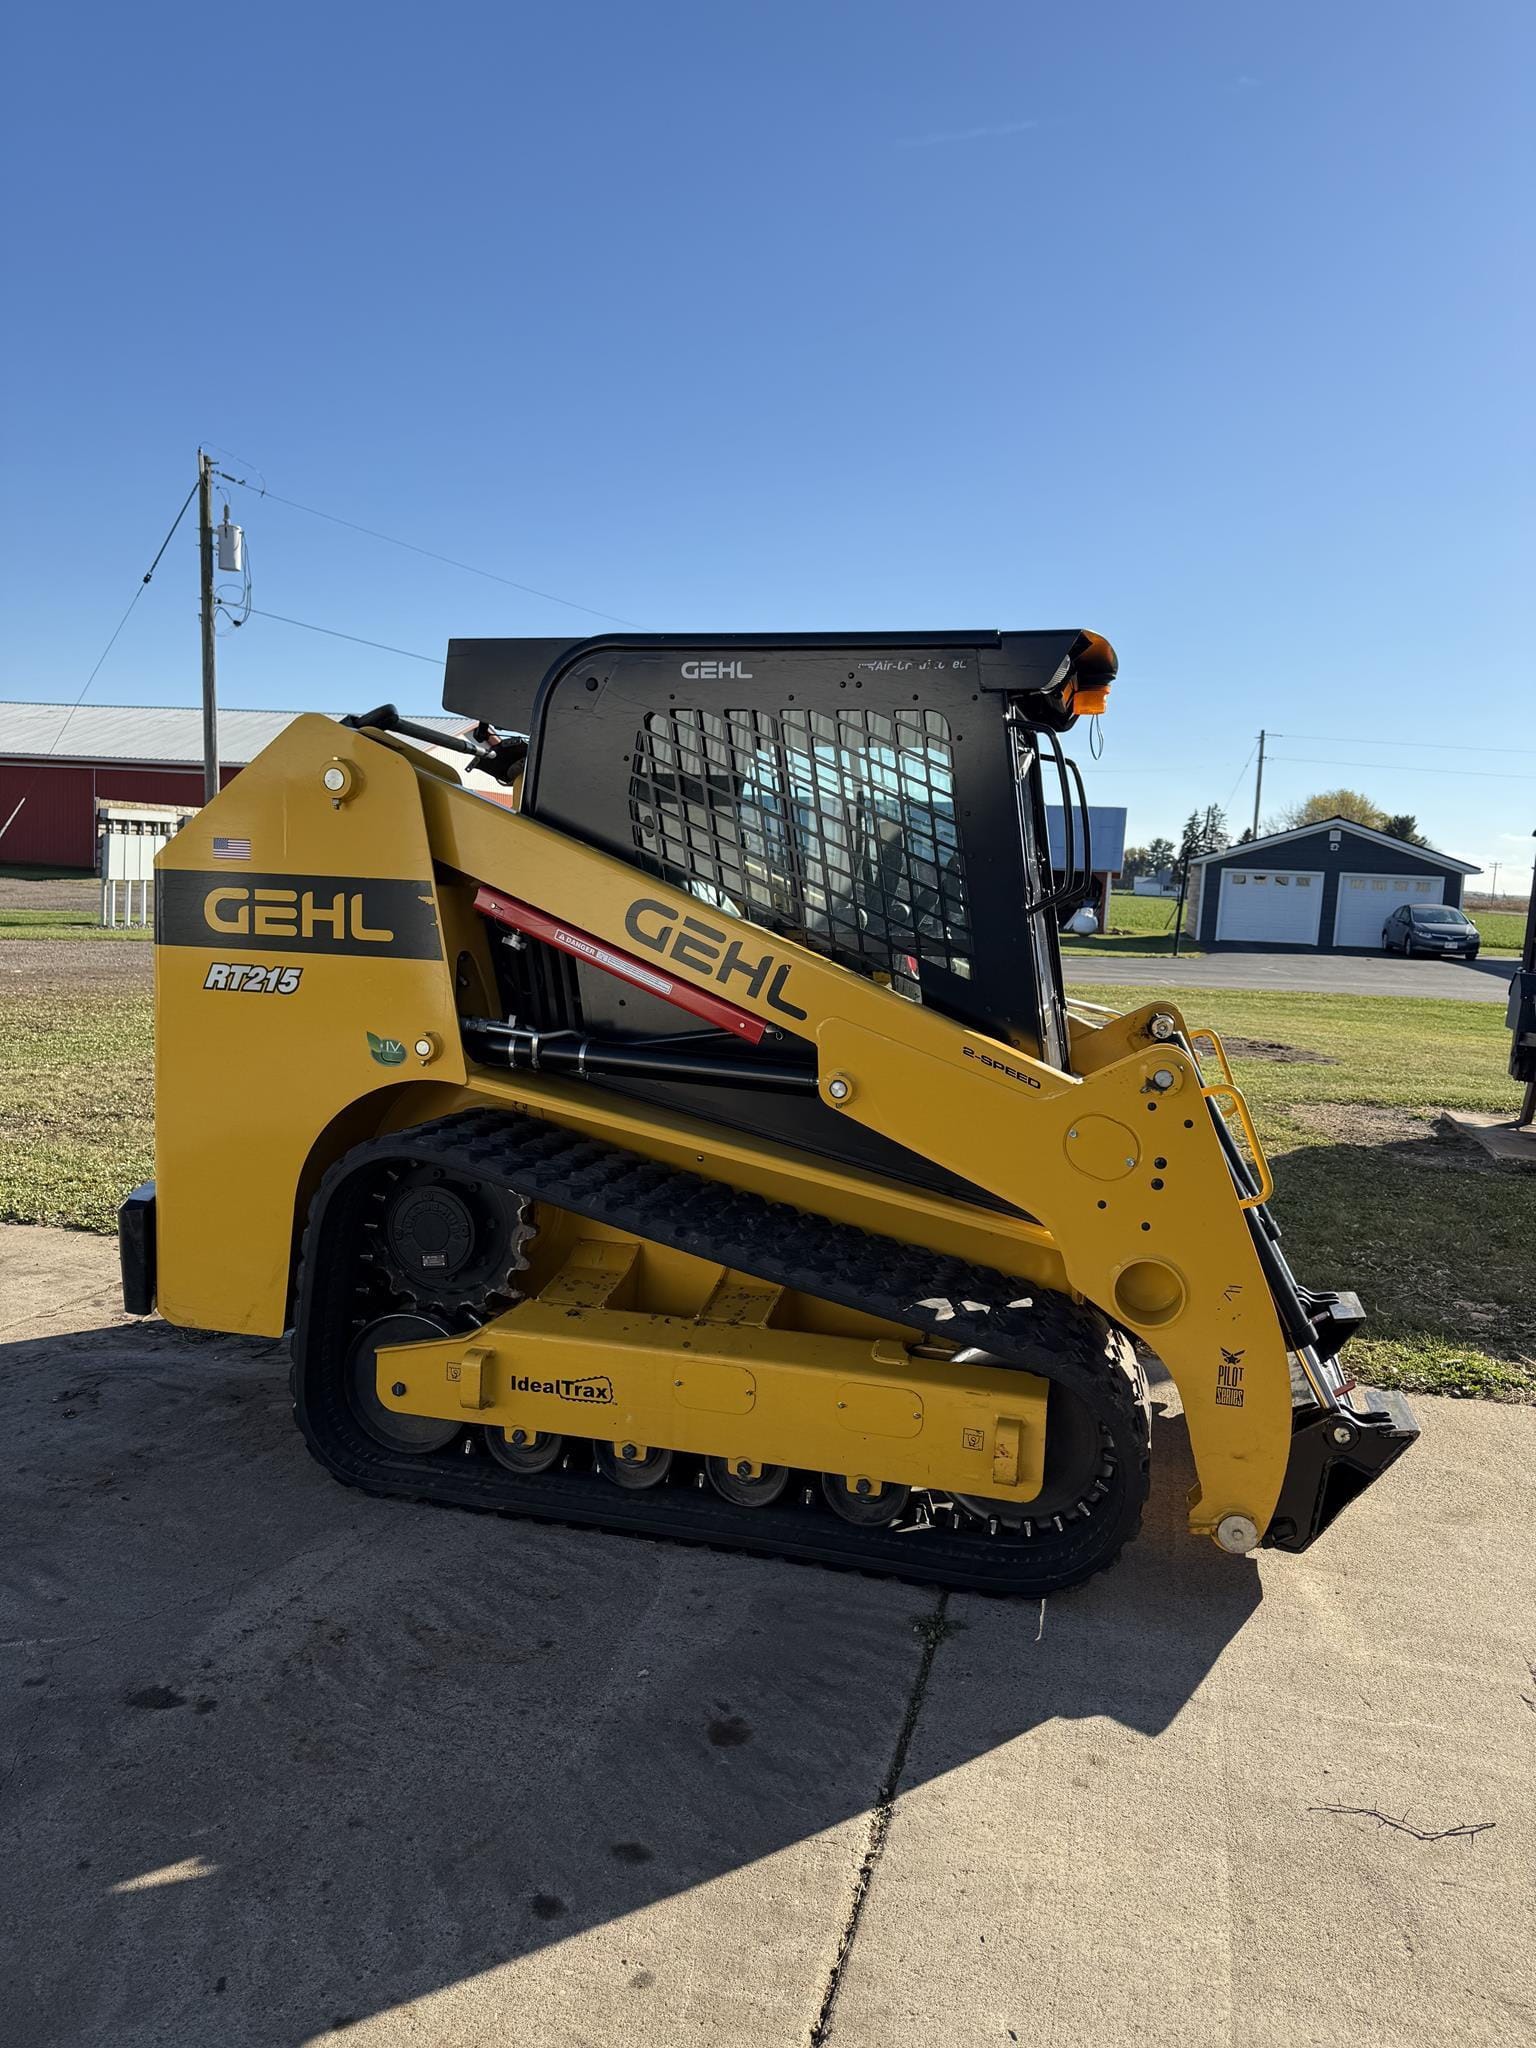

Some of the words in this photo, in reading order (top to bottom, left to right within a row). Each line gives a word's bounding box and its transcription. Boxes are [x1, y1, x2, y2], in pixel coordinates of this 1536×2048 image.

[680, 661, 753, 679] GEHL
[203, 887, 394, 942] GEHL
[566, 935, 596, 958] DANGER
[625, 898, 808, 1021] GEHL
[203, 962, 304, 995] RT215
[962, 1046, 1041, 1089] 2-SPEED
[511, 1375, 609, 1400] IdealTrax
[1218, 1365, 1244, 1387] PILOT
